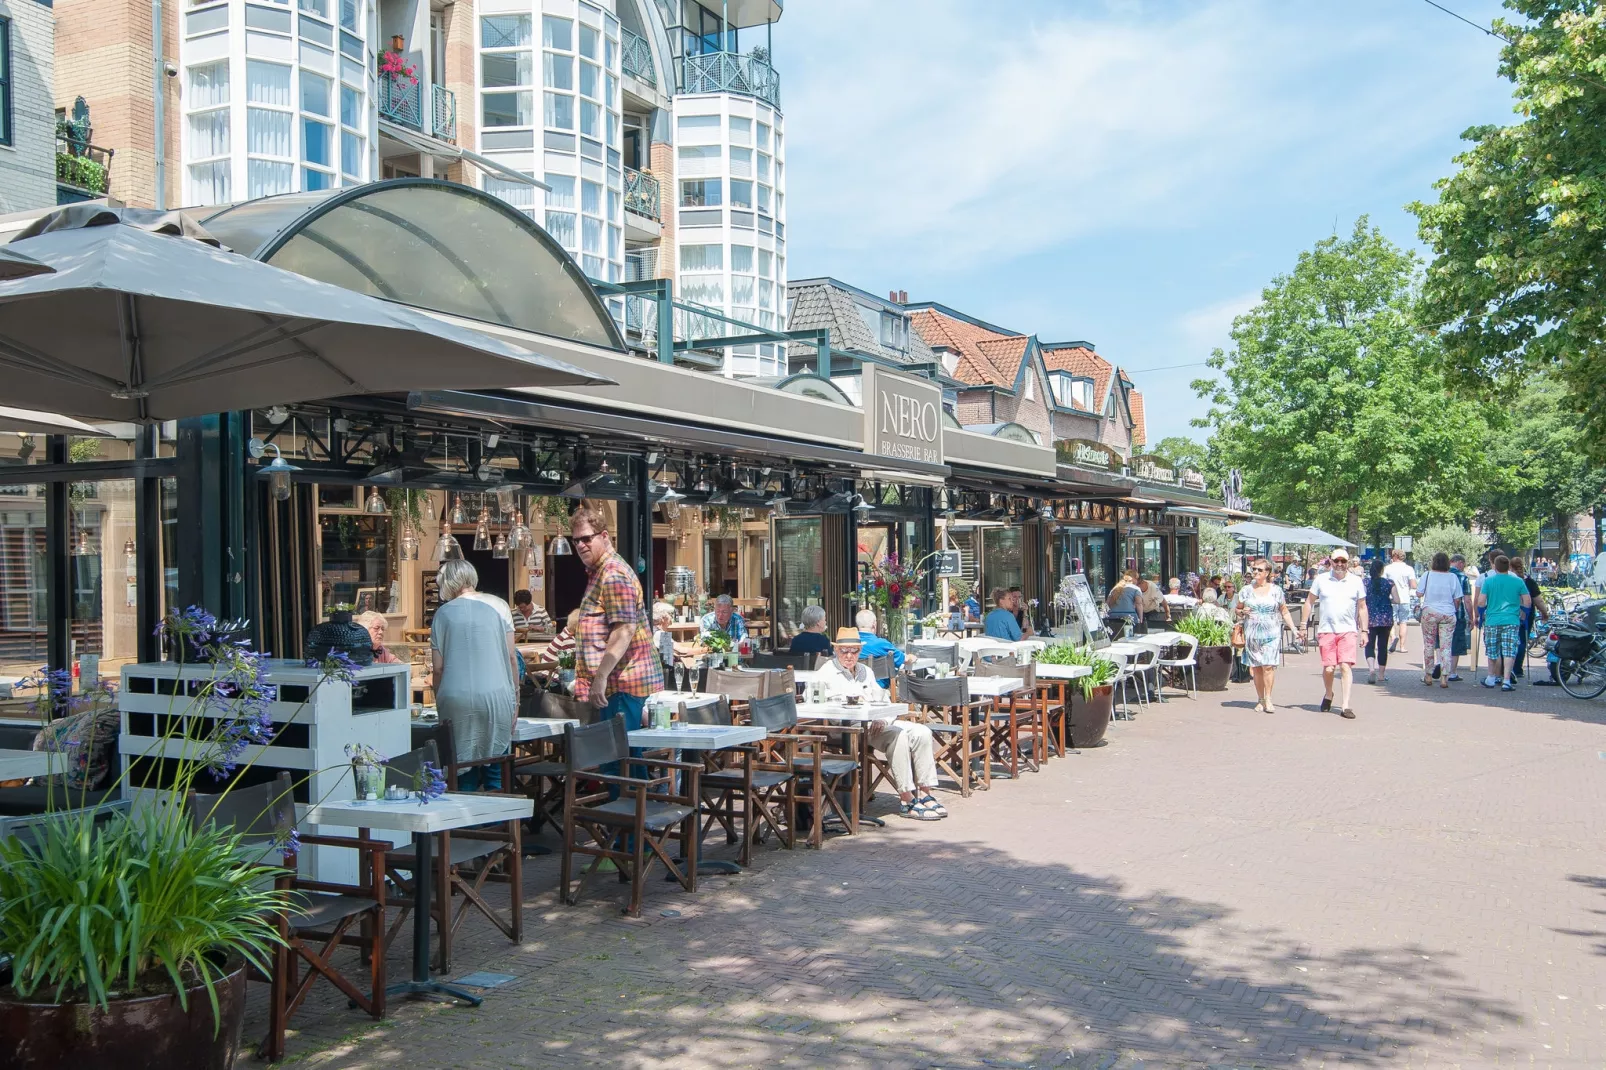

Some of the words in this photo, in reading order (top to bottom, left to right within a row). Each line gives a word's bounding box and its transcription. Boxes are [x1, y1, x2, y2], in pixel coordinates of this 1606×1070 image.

[882, 390, 938, 442] NERO
[882, 440, 921, 461] BRASSERIE
[924, 448, 938, 463] BAR
